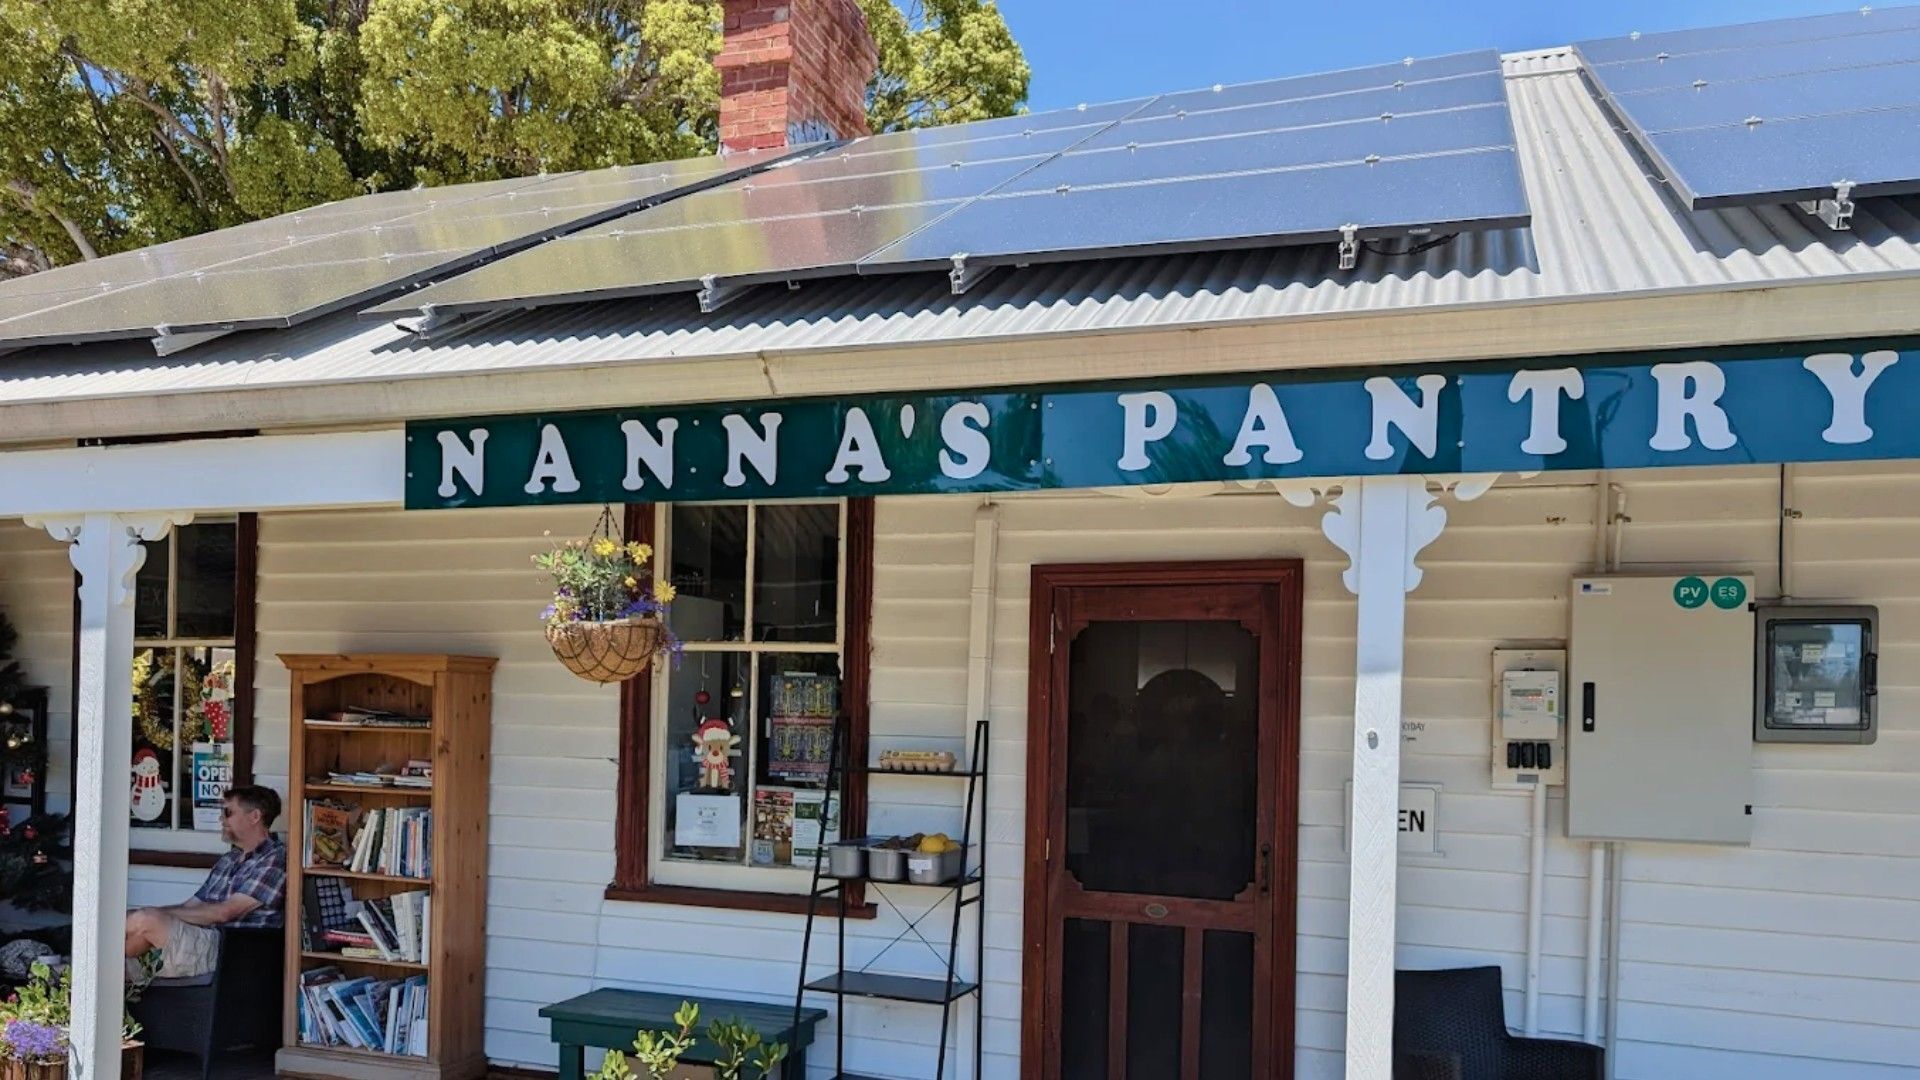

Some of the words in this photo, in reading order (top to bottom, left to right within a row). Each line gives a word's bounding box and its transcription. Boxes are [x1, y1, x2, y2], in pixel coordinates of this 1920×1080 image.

[437, 403, 990, 498] NANNA'S
[1118, 351, 1900, 472] PANTRY
[1679, 586, 1702, 599] PV
[1718, 586, 1738, 598] ES
